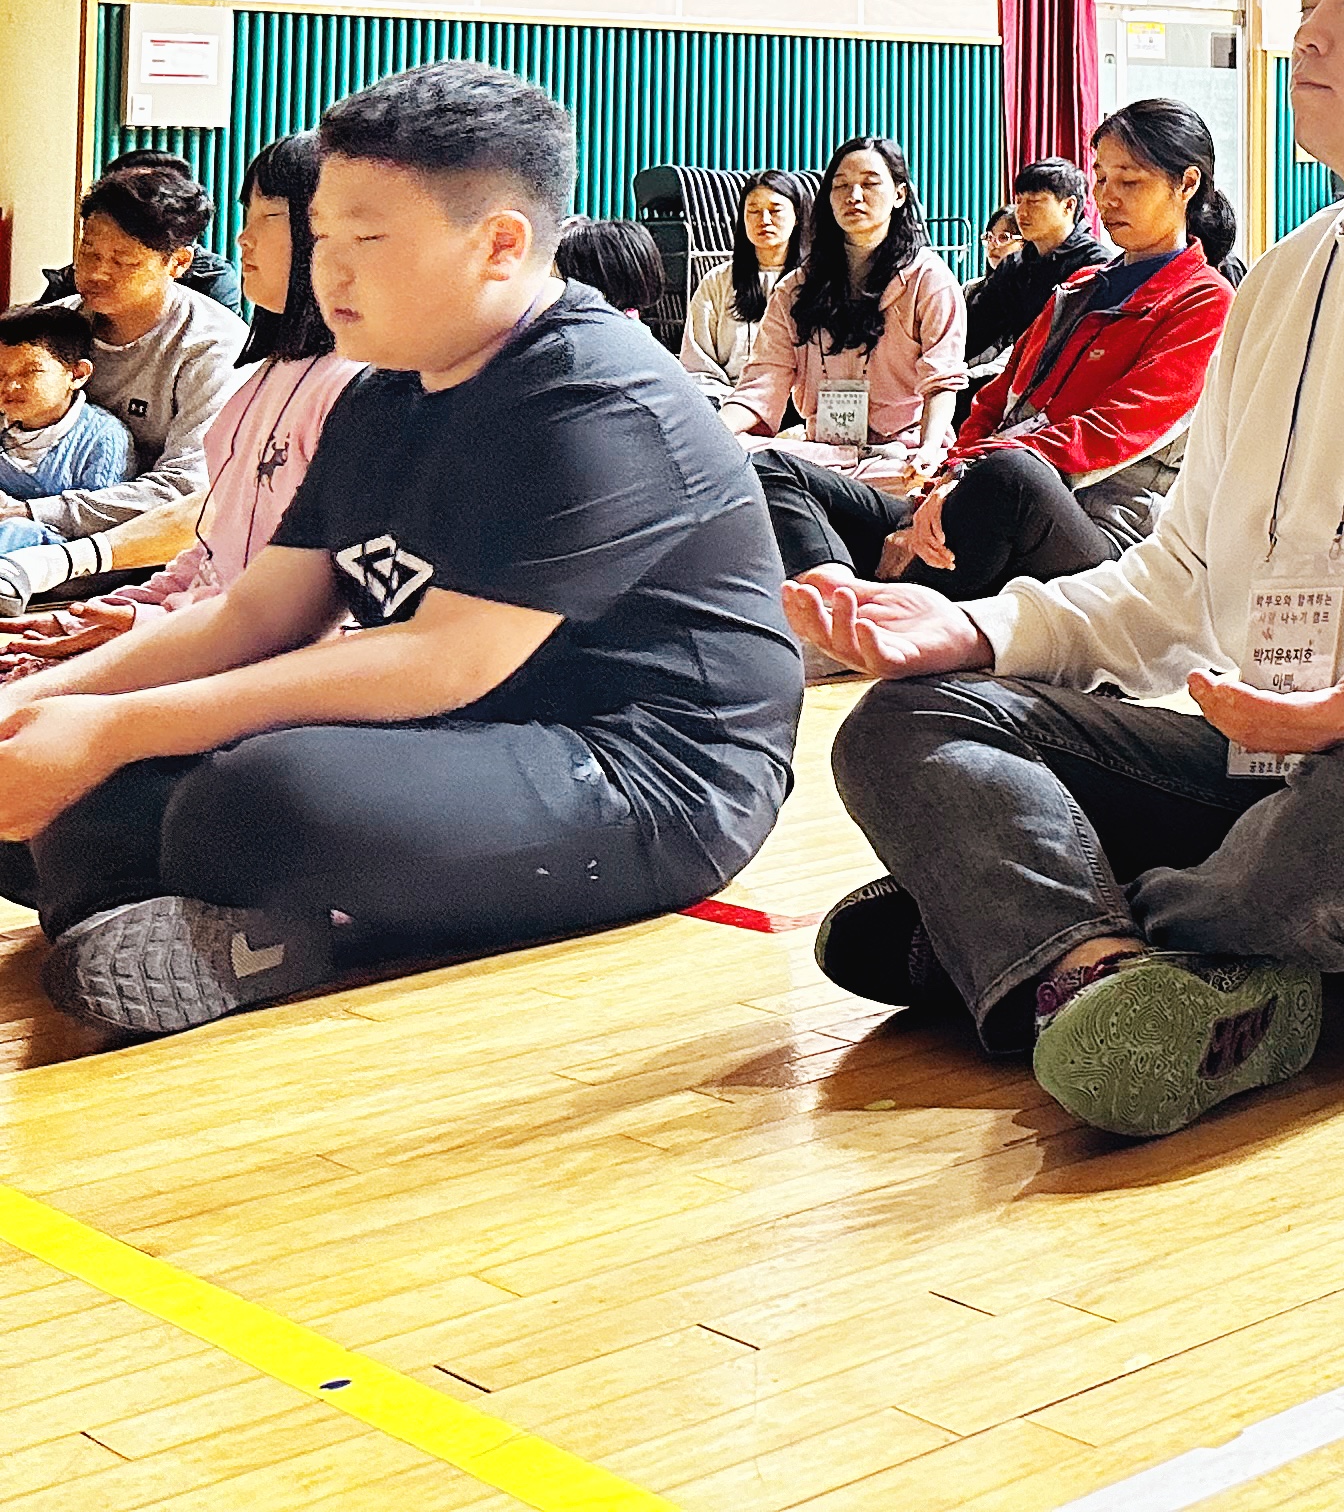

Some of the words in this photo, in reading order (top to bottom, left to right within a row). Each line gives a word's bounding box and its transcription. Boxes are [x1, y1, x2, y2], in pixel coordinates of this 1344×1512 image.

[1281, 611, 1308, 624] 나누기
[1313, 611, 1330, 624] 캠프
[1253, 647, 1313, 666] 박지윤&지호
